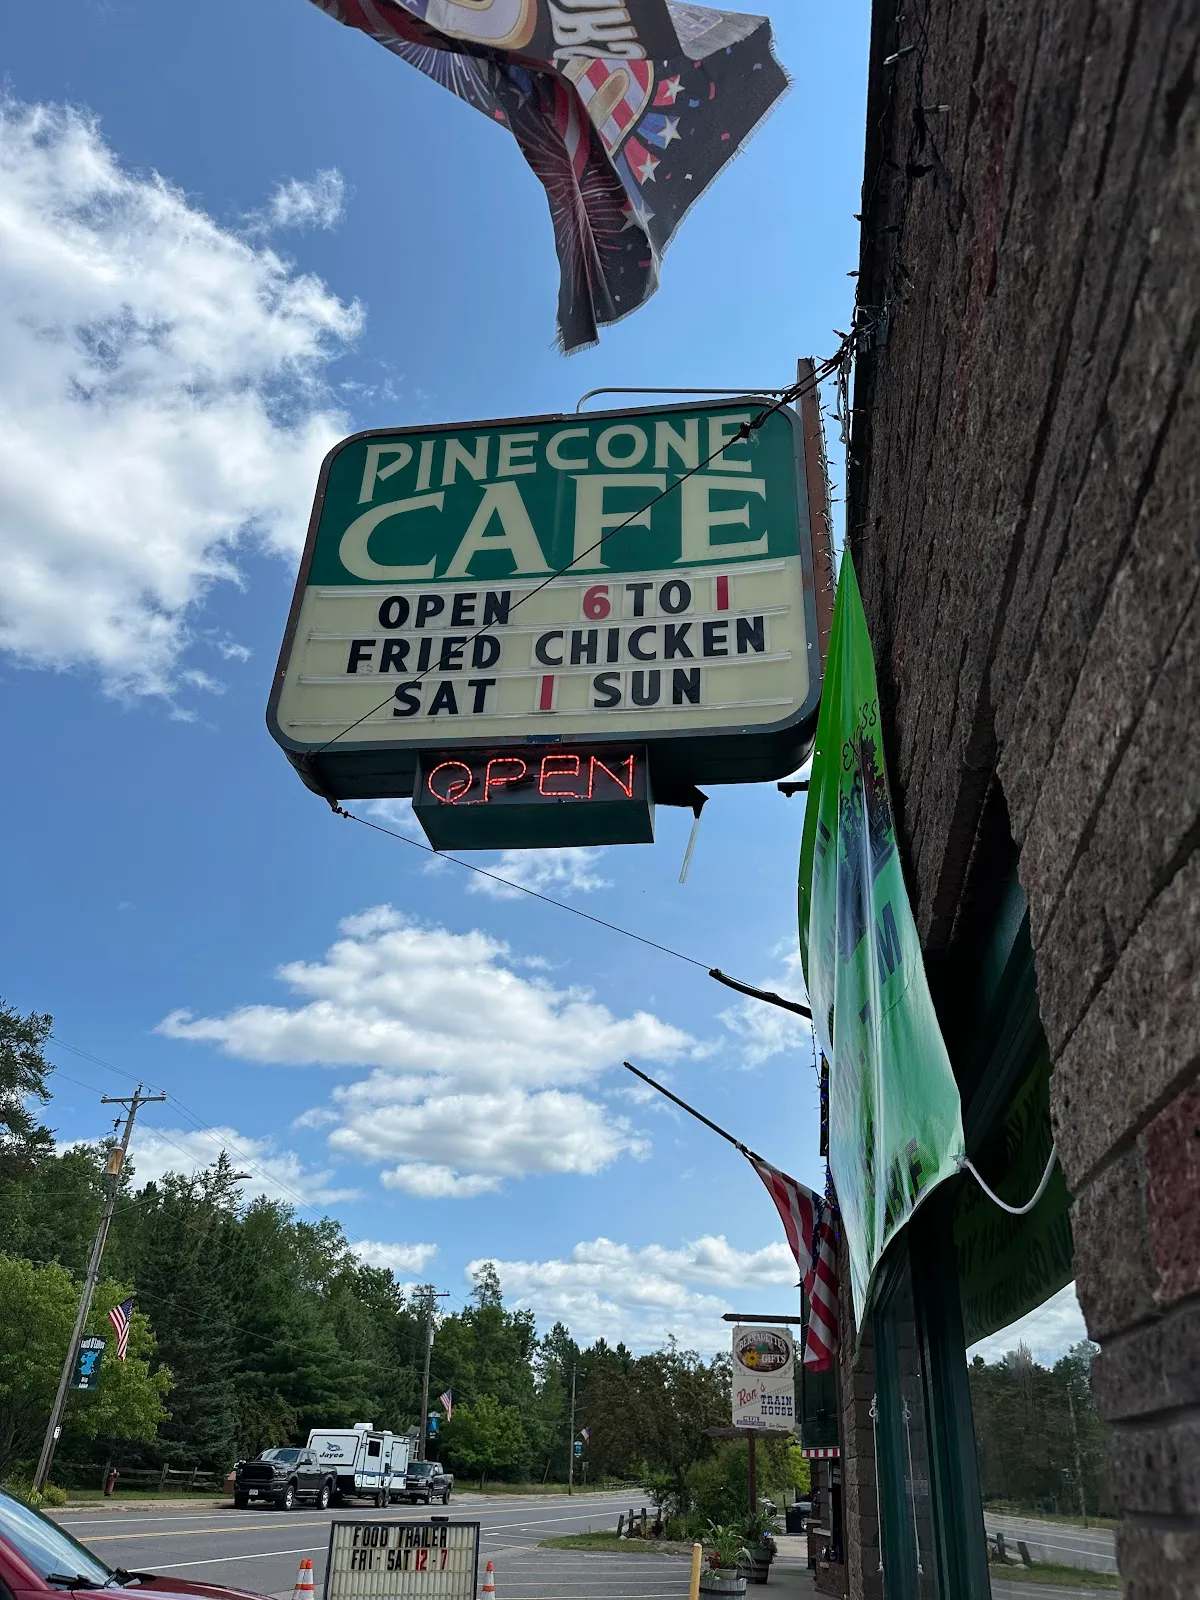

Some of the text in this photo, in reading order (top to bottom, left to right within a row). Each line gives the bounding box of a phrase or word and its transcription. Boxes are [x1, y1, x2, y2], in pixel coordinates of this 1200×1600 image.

[358, 413, 752, 504] PINECONE
[339, 473, 768, 581] CAFE
[378, 590, 511, 629] OPEN
[346, 616, 766, 673] FRIED CHICKEN
[393, 678, 497, 717] SAT
[593, 667, 701, 708] SUN
[428, 754, 635, 804] OPEN
[761, 1353, 786, 1364] GIFTS
[760, 1395, 792, 1406] TRAIN
[760, 1405, 793, 1416] HOUSE
[319, 1451, 344, 1459] Jayco
[352, 1526, 448, 1548] FOOD TRAILER
